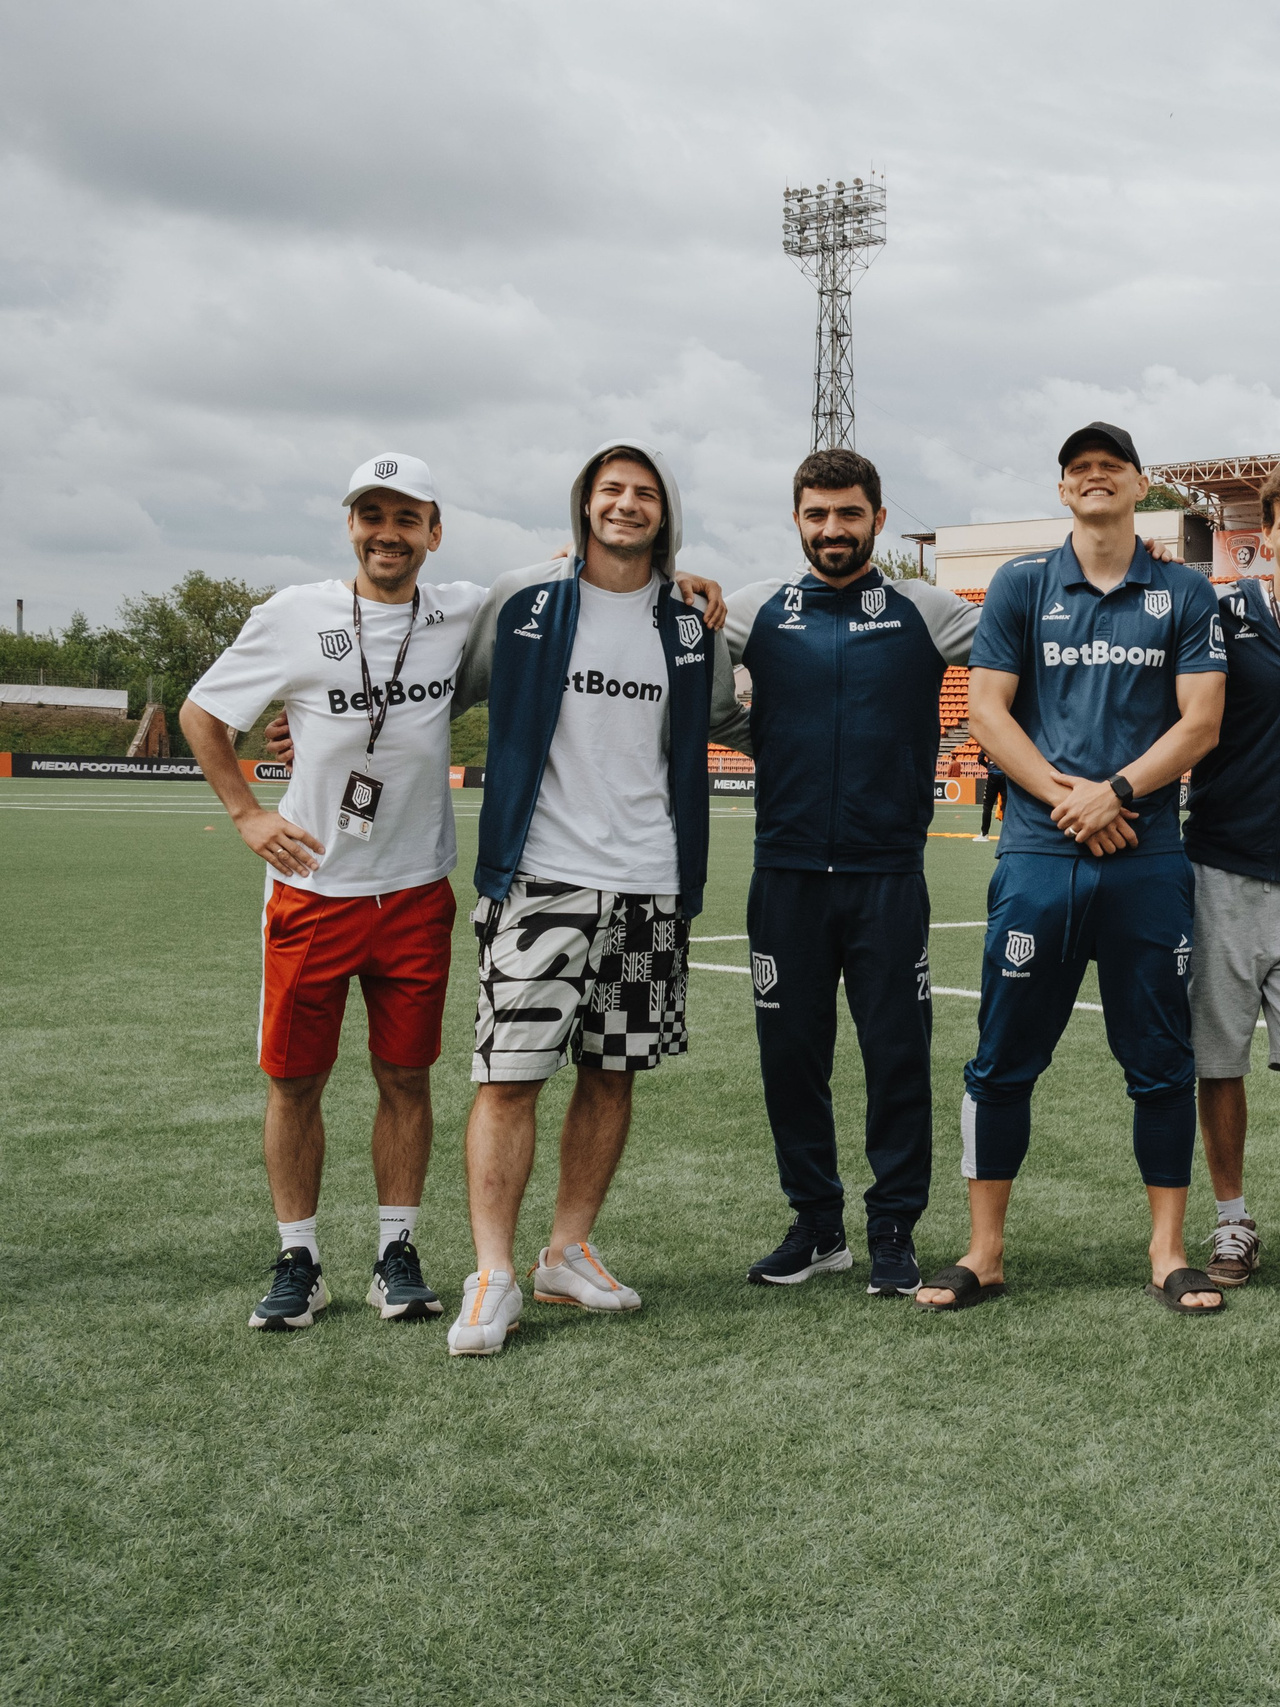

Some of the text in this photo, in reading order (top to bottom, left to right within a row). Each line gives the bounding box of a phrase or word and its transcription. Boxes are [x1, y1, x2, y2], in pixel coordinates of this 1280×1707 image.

[531, 590, 549, 615] 9
[784, 587, 803, 612] 23
[1230, 597, 1246, 620] 14
[513, 628, 543, 640] DEMIX
[849, 620, 901, 632] BetBoom
[1043, 640, 1166, 668] BetBoom
[32, 761, 78, 772] MEDIA
[79, 761, 151, 773] FOOTBALL
[1002, 968, 1031, 978] BetBoom
